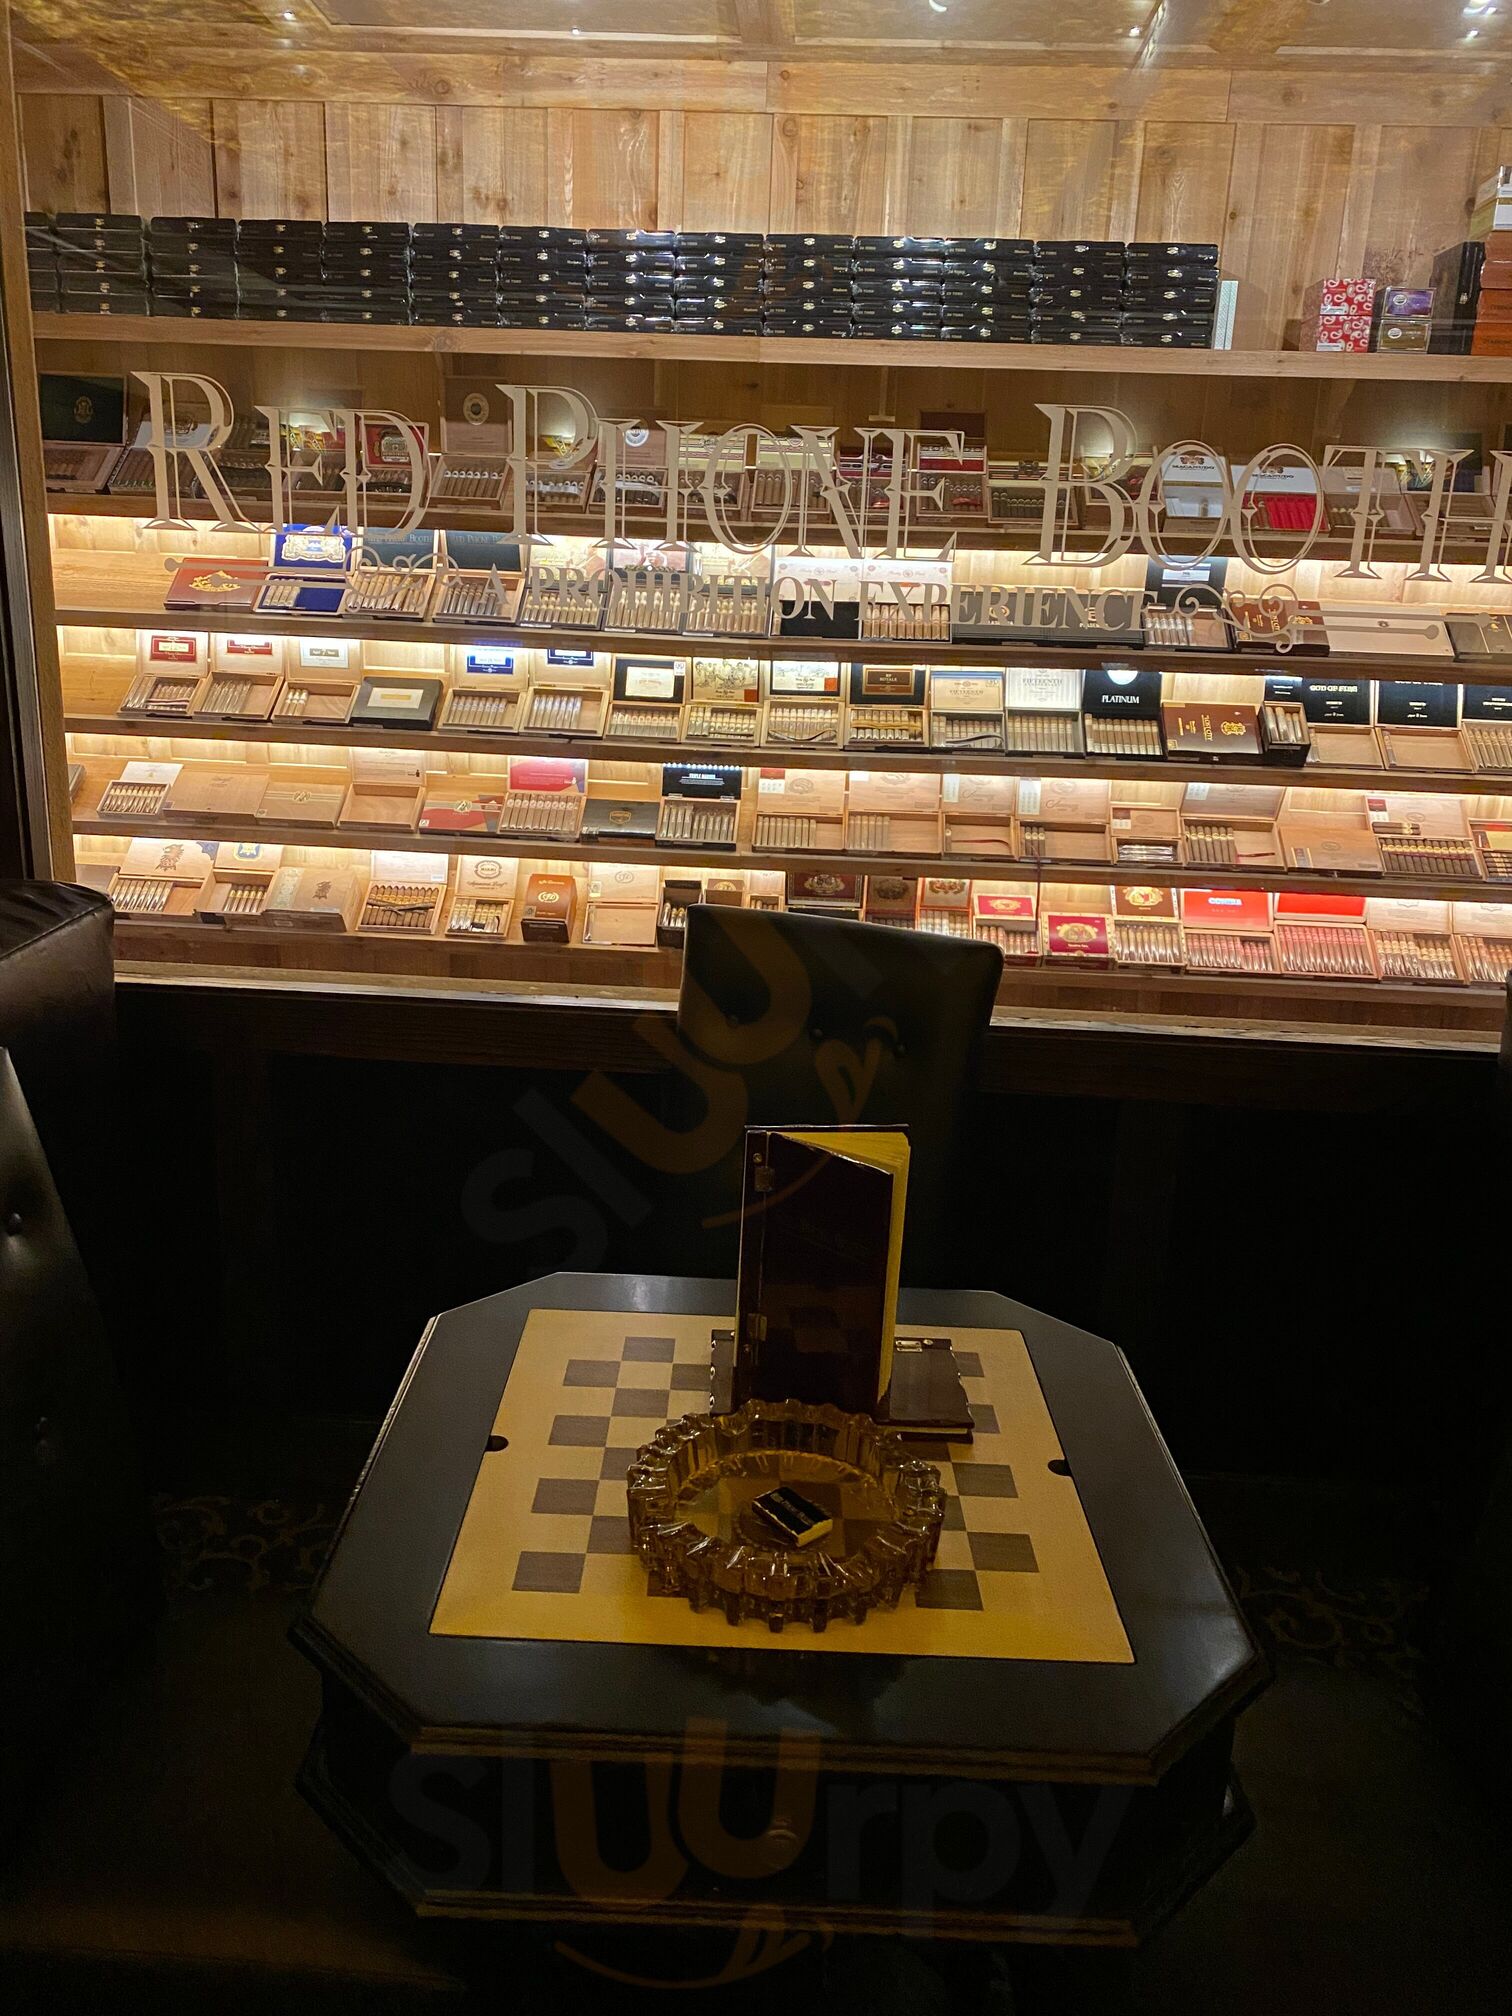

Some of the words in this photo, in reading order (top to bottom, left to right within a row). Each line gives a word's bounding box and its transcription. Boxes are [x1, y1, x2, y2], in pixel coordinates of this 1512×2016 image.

[131, 371, 432, 537] RED
[495, 385, 965, 560] PHONE
[1022, 403, 1512, 583] BOOTH
[476, 563, 509, 605] A
[531, 566, 836, 621] PROHIBITION
[855, 580, 1159, 631] EXPERIENCE
[1101, 694, 1139, 704] PLATINUM
